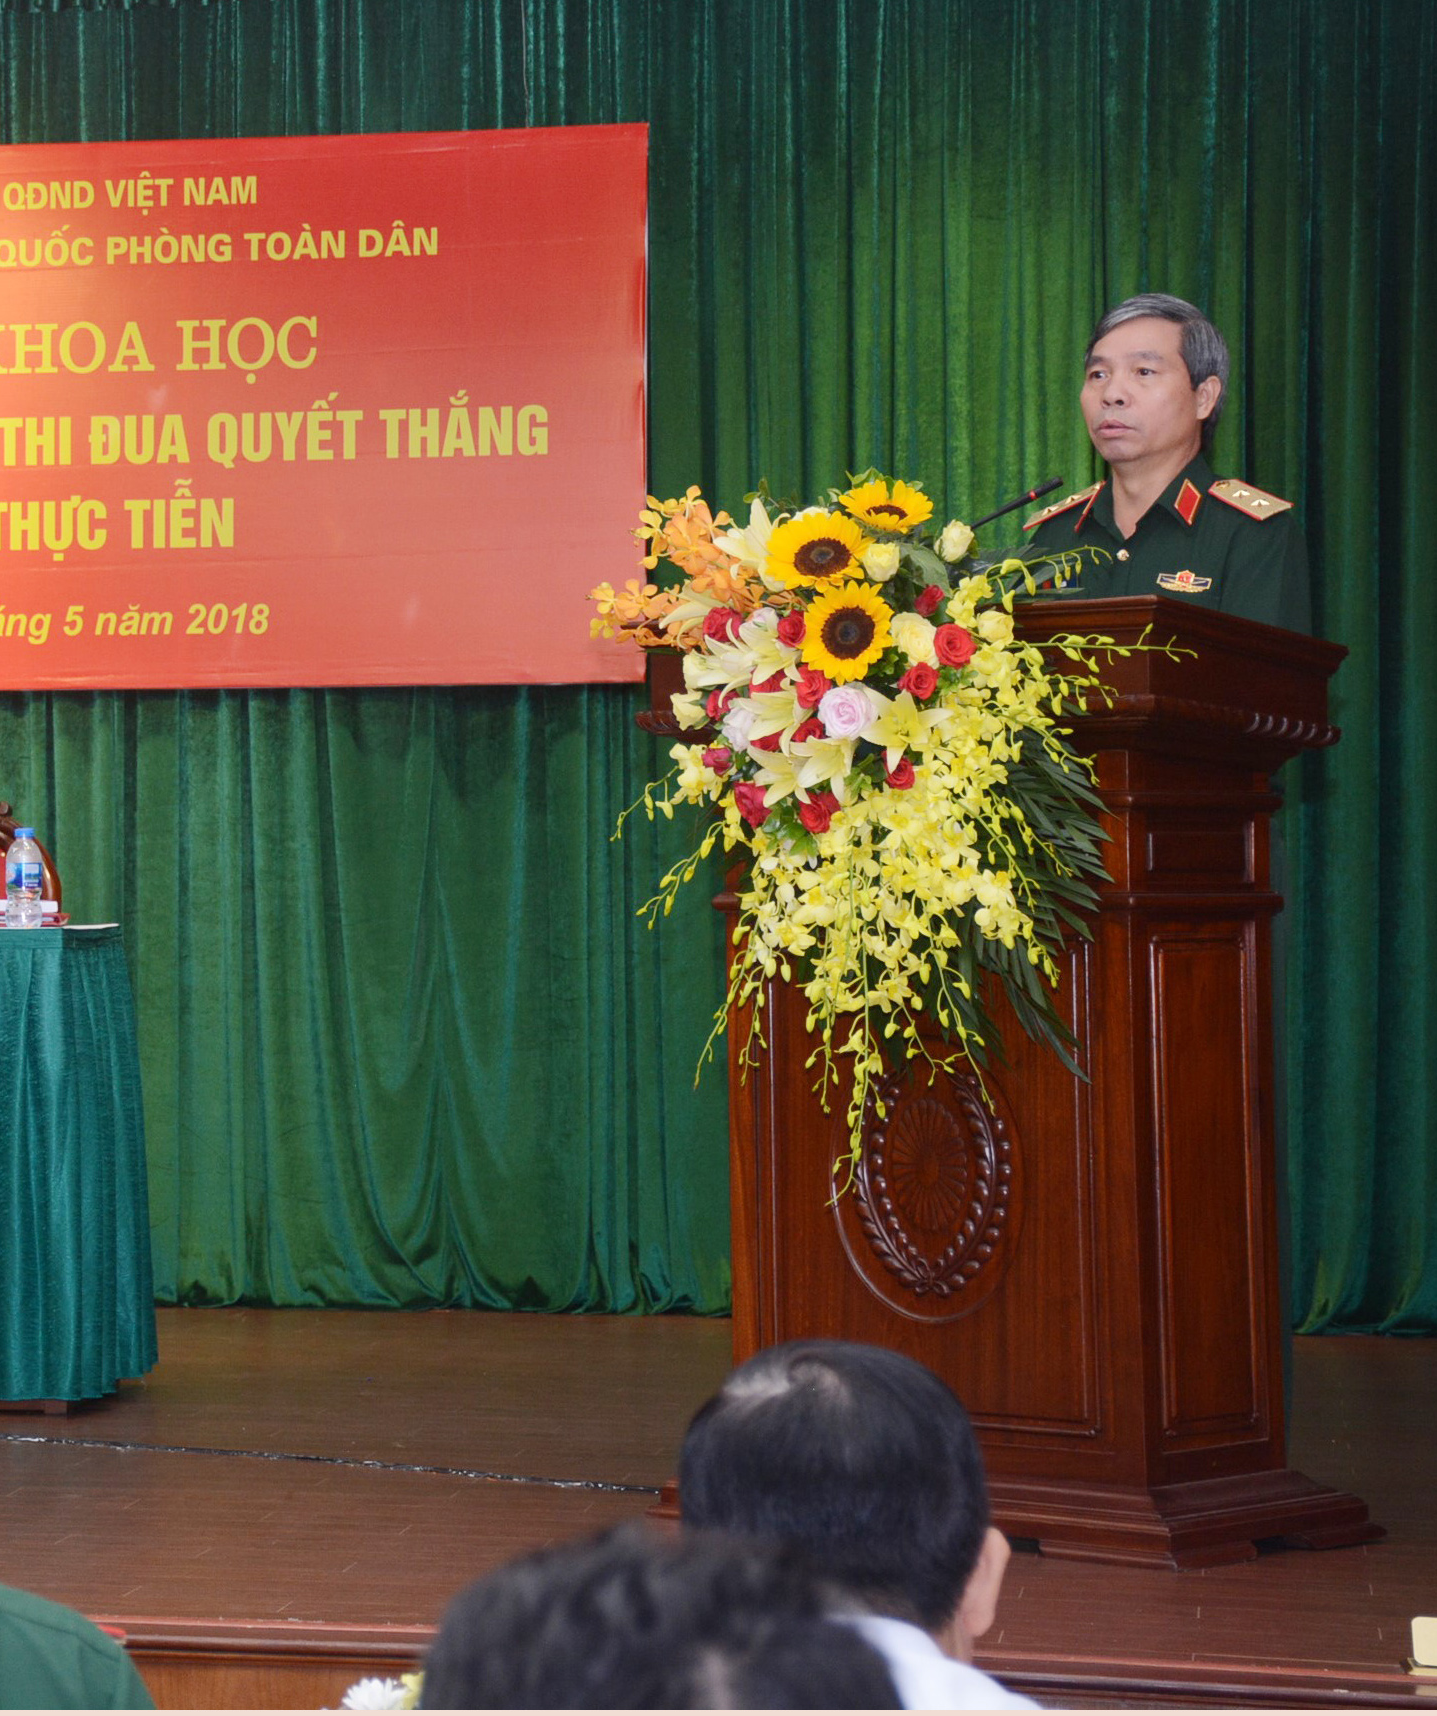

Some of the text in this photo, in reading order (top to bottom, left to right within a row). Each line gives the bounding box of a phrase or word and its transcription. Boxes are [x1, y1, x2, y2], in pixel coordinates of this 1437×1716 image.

[3, 180, 95, 212] QĐND
[104, 170, 175, 216] VIỆT
[183, 175, 258, 206] NAM
[106, 227, 232, 265] PHÒNG
[243, 223, 346, 261] TOÀN
[358, 219, 438, 258] DÂN
[176, 315, 318, 384] HỌC
[88, 414, 190, 466] ĐUA
[207, 391, 364, 469] QUYẾT
[378, 389, 549, 459] THẮNG
[123, 478, 235, 549] TIỄN
[63, 605, 85, 637] 5
[94, 604, 174, 636] năm
[185, 602, 270, 635] 2018
